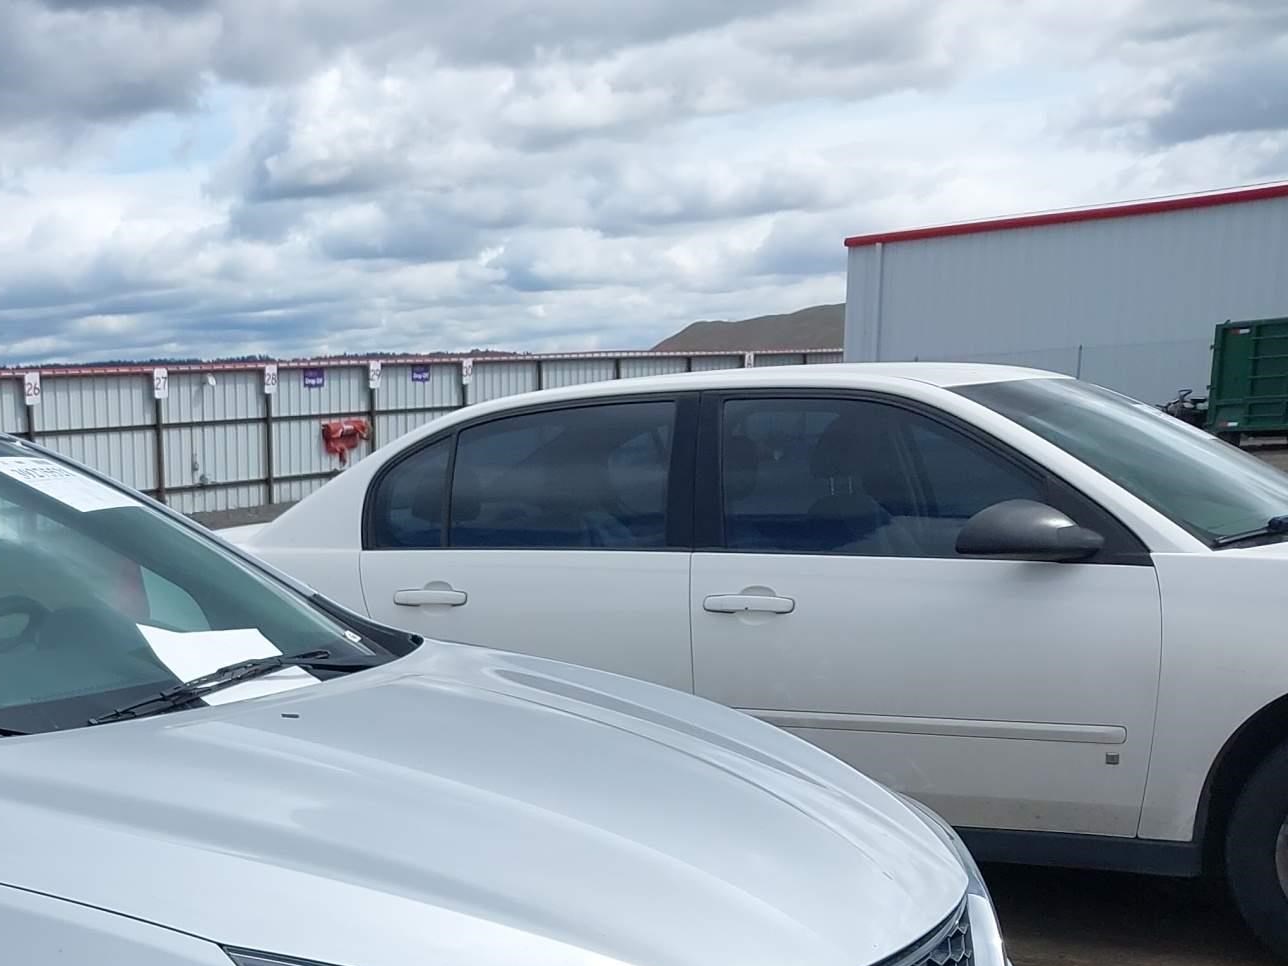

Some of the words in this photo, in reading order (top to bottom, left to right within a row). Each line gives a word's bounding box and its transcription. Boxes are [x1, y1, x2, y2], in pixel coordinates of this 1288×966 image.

[265, 372, 277, 386] 28
[368, 368, 381, 381] 29
[25, 382, 40, 397] 26
[155, 376, 168, 391] 27
